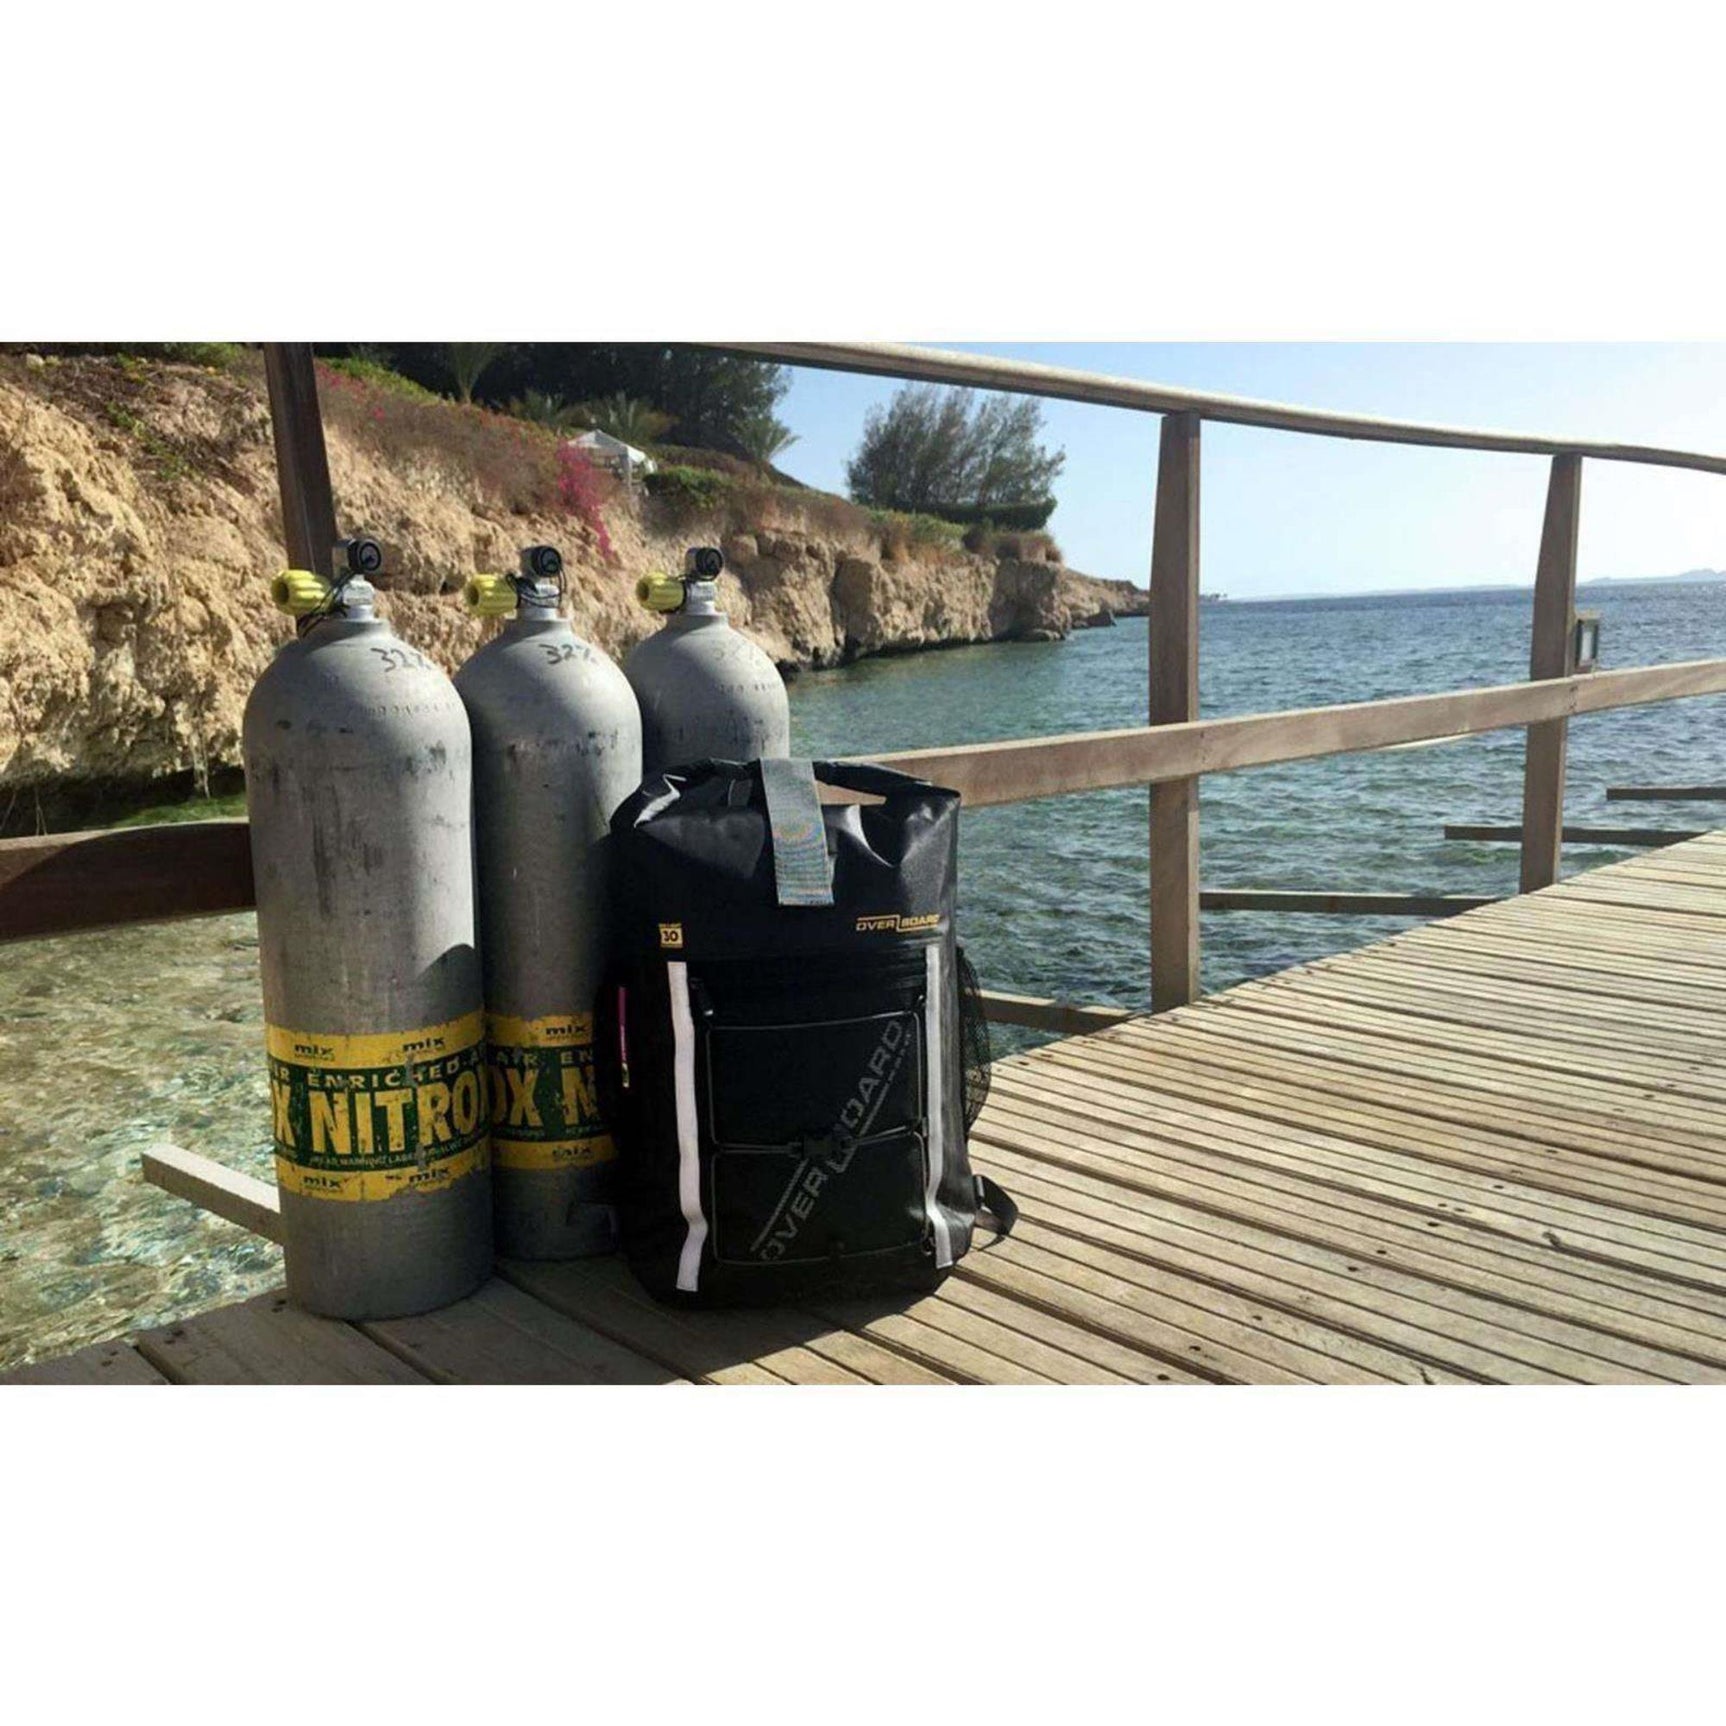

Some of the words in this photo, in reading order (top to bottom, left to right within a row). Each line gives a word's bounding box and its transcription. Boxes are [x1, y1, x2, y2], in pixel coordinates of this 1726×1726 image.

[662, 930, 678, 942] 30
[546, 1024, 586, 1035] mix
[294, 1043, 334, 1056] mix
[403, 1036, 445, 1051] mix
[303, 1175, 342, 1188] mix
